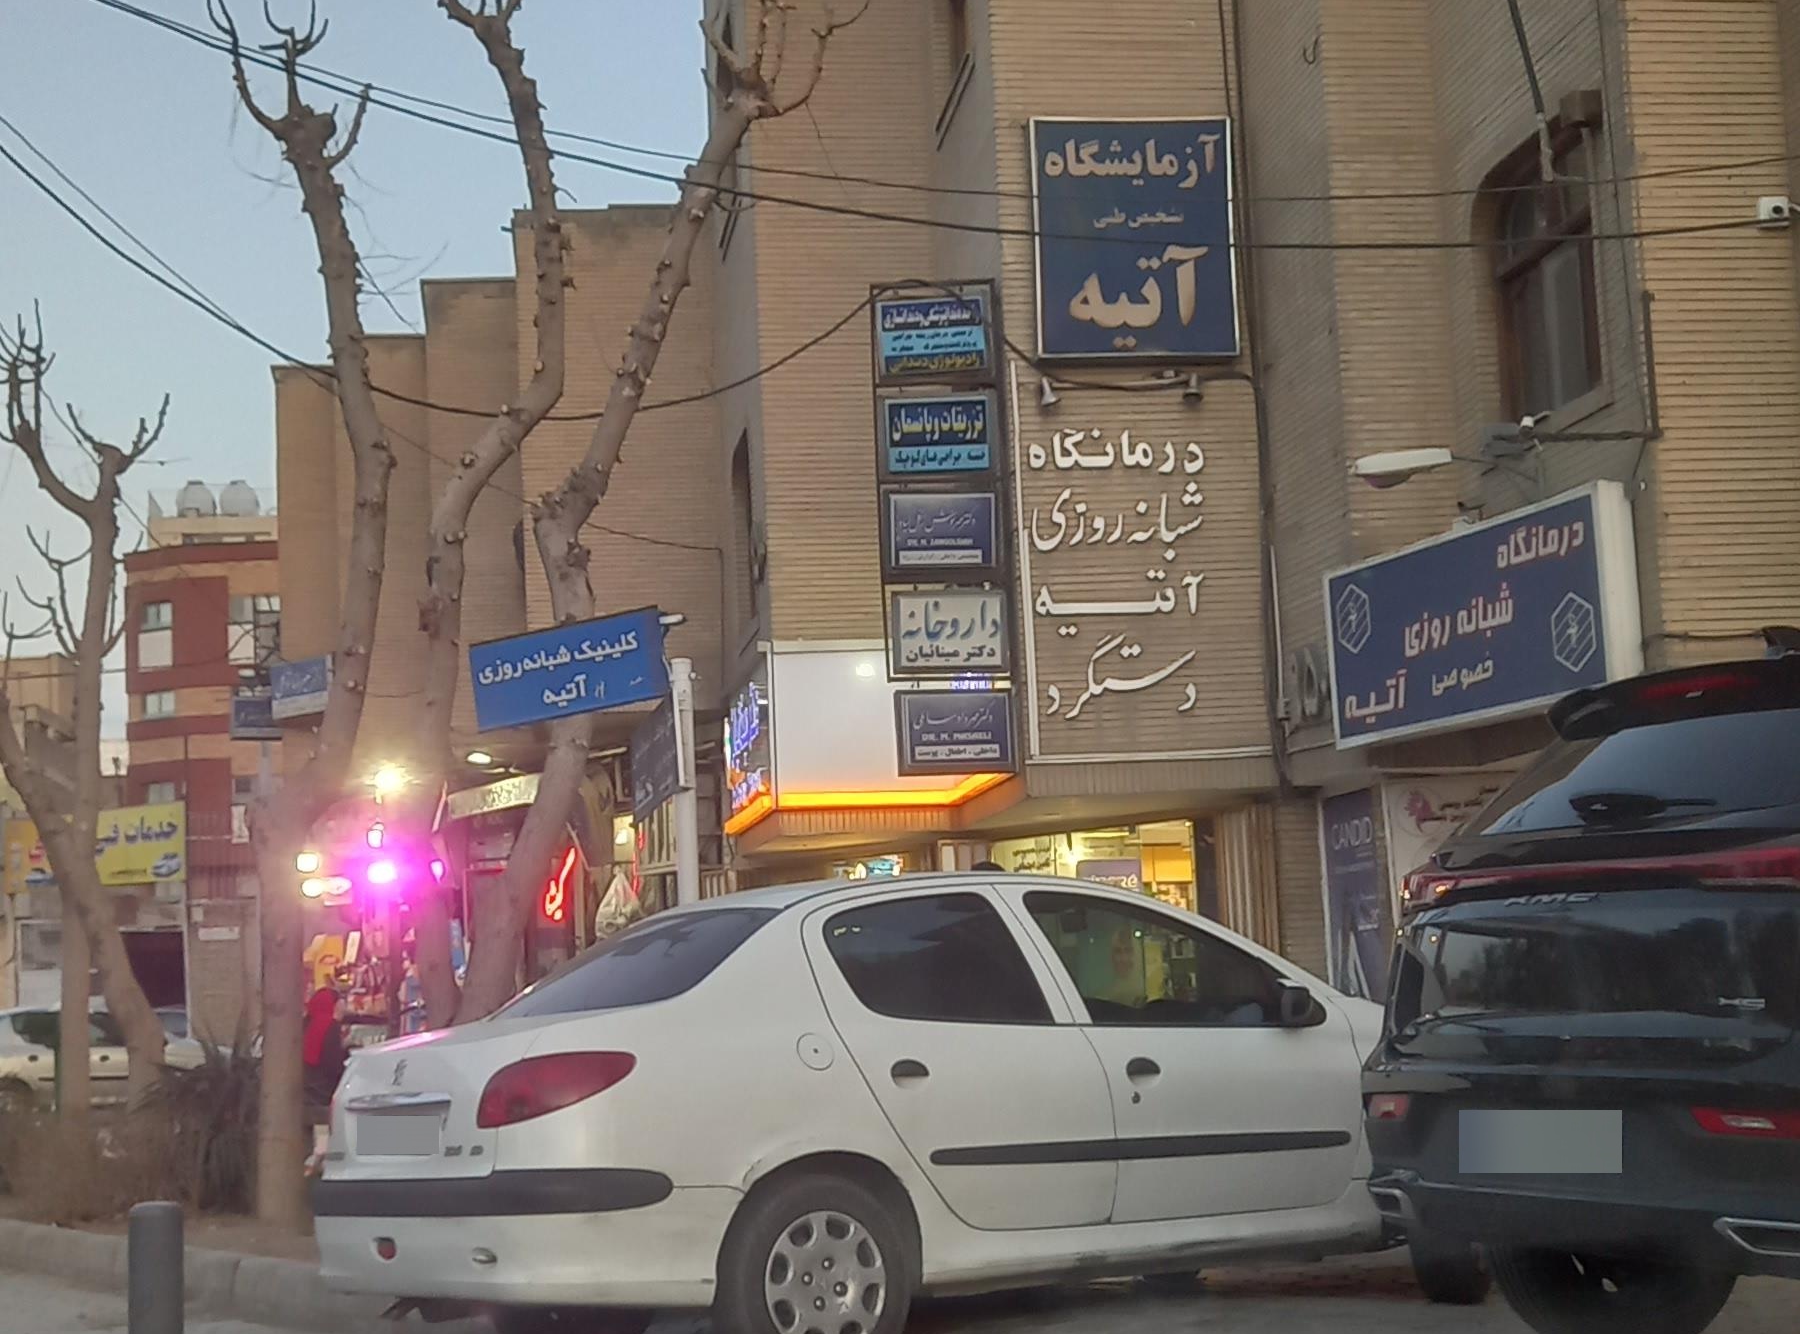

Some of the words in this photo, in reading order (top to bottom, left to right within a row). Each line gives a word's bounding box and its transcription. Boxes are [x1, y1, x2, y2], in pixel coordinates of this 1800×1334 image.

[1044, 133, 1221, 189] آزمایشگاه
[1069, 244, 1209, 349] آتیه
[941, 405, 984, 441] تزریقات
[1028, 427, 1205, 474] درمانگاه
[1496, 521, 1584, 569] درمانگاه
[902, 599, 999, 643] داروخانه
[1035, 569, 1205, 637] آتیه
[1456, 582, 1515, 637] شبانه
[574, 630, 639, 662] کلینیک
[963, 644, 996, 663] دکتر
[1404, 612, 1450, 659] روزی
[543, 674, 587, 707] آتیه
[1046, 634, 1197, 720] دستگرد
[1344, 669, 1408, 724] آتیه
[1431, 651, 1494, 697] خصوصی
[124, 814, 178, 843] خدمات
